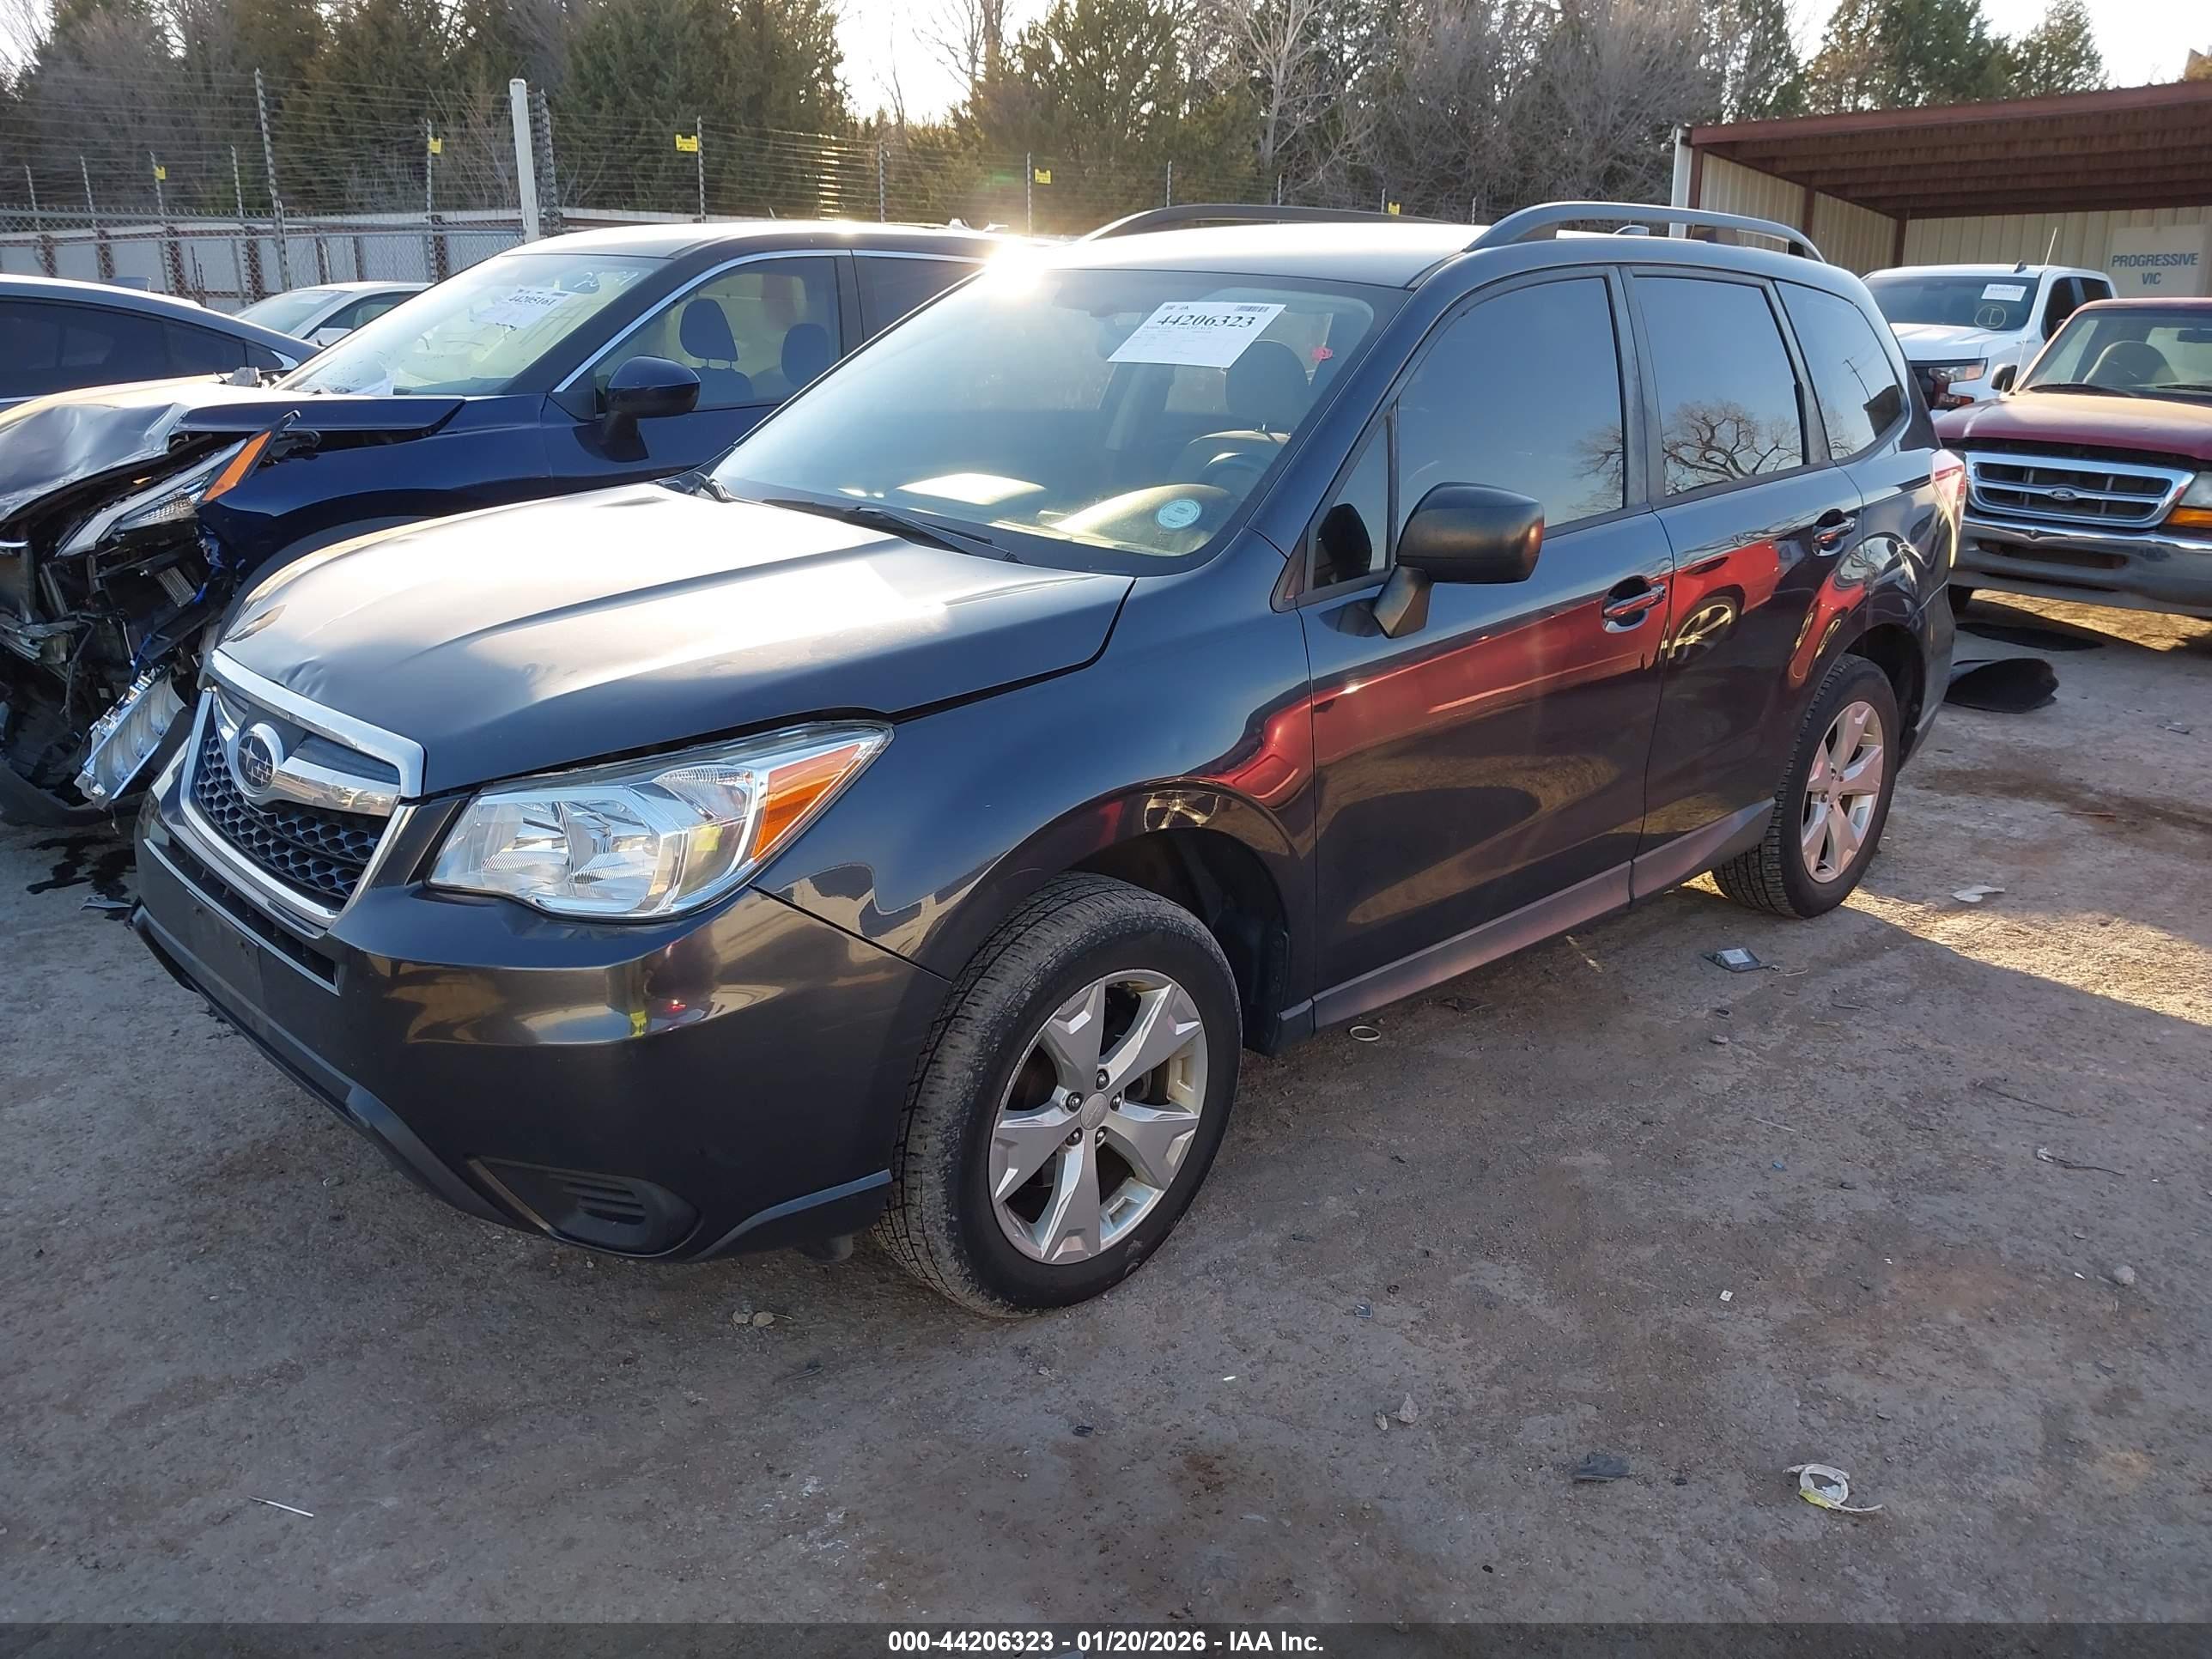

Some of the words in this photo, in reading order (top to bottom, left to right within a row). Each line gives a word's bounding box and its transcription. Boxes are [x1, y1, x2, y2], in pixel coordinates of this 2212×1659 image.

[2112, 252, 2199, 267] PROGRESSIVE
[2142, 272, 2162, 285] VIC
[1157, 314, 1256, 328] 44206323
